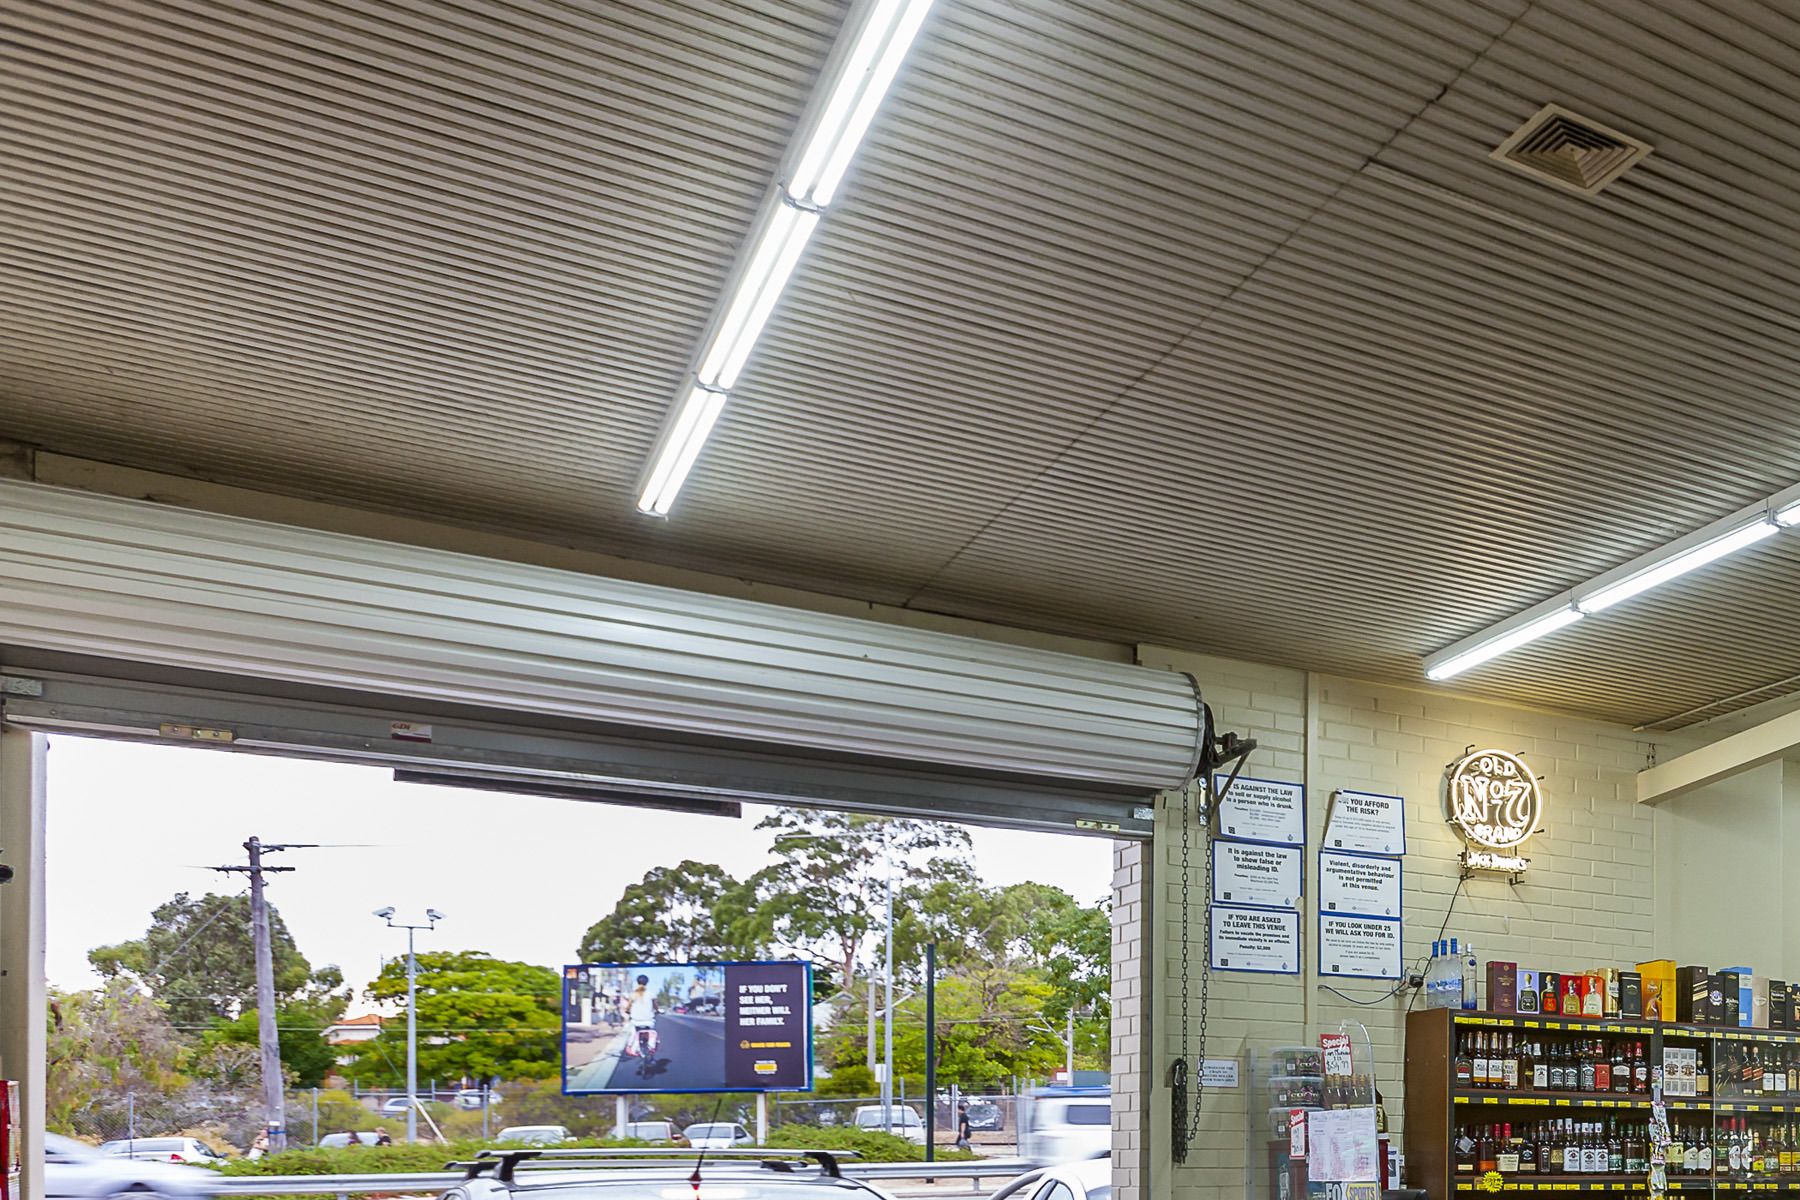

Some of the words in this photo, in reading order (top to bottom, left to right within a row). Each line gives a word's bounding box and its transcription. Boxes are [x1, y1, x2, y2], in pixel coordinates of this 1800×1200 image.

[1365, 800, 1389, 809] AFFORD
[1474, 824, 1522, 841] BRAND
[1237, 864, 1269, 872] misleading
[1352, 862, 1379, 871] disorderly
[739, 985, 747, 993] IF
[748, 985, 763, 993] YOU
[739, 996, 754, 1004] SEE
[772, 1006, 791, 1014] WILL
[1350, 1187, 1375, 1200] SPORTS
